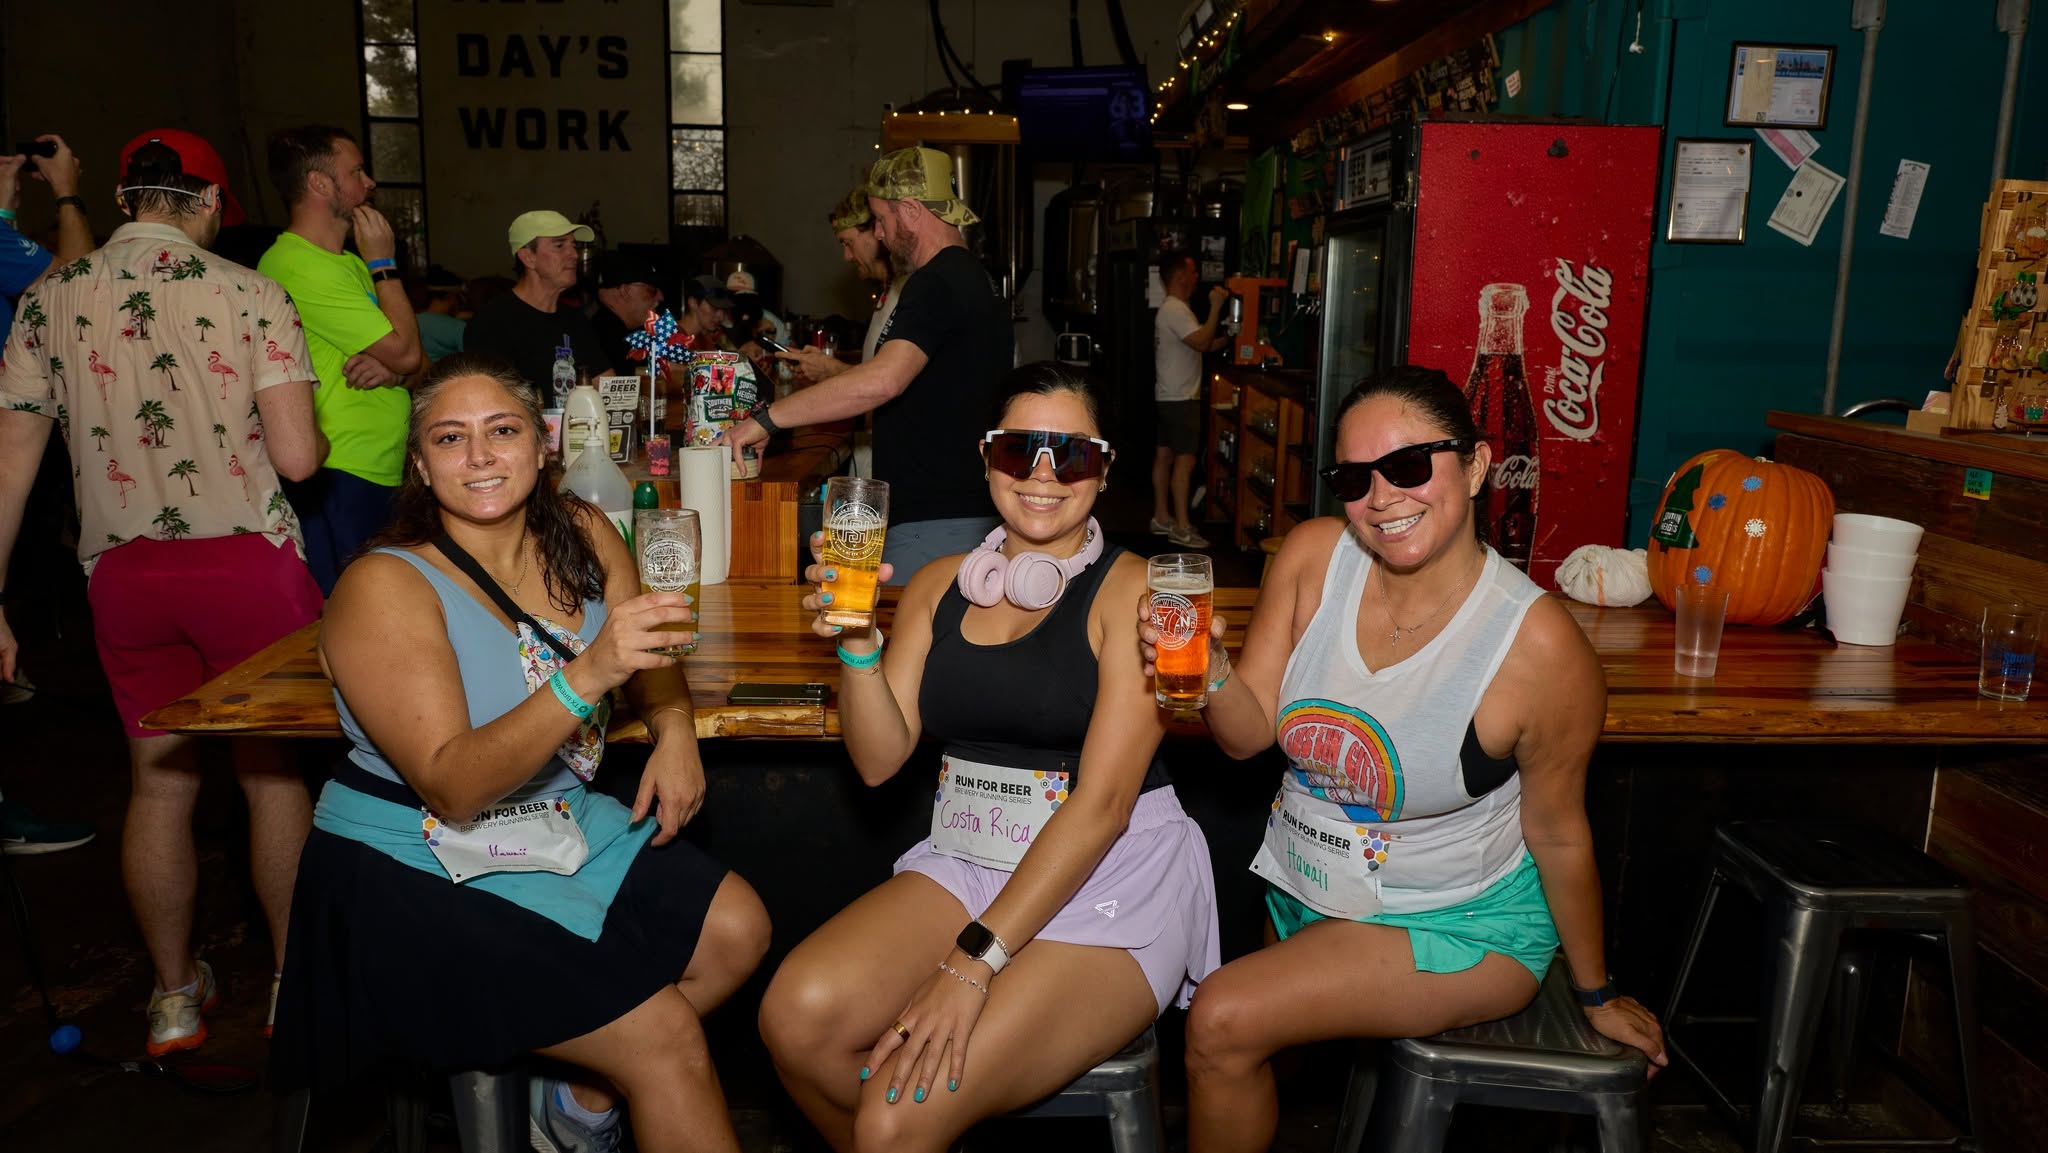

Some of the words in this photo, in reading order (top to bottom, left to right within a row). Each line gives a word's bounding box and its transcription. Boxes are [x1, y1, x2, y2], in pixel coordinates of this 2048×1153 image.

[457, 32, 629, 79] DAY'S
[458, 107, 632, 152] WORK
[1543, 256, 1613, 440] Coca-Cola
[610, 383, 637, 392] BEER
[955, 774, 975, 789] RUN
[976, 779, 998, 792] FOR
[1000, 783, 1032, 797] BEER
[1345, 741, 1376, 799] CITY
[494, 806, 518, 820] FOR
[519, 801, 549, 815] BEER
[954, 786, 979, 800] BREWERY
[979, 791, 1008, 803] RUNNING
[1008, 795, 1032, 805] SERIES
[460, 821, 498, 833] BREWERY
[498, 815, 531, 827] RUNNING
[940, 799, 982, 834] Costa
[989, 806, 1032, 844] Rica
[1282, 809, 1298, 830] RUN
[1298, 821, 1317, 840] FOR
[1319, 831, 1351, 851] BEER
[1300, 834, 1327, 852] RUNNING
[1327, 844, 1350, 859] SERIES
